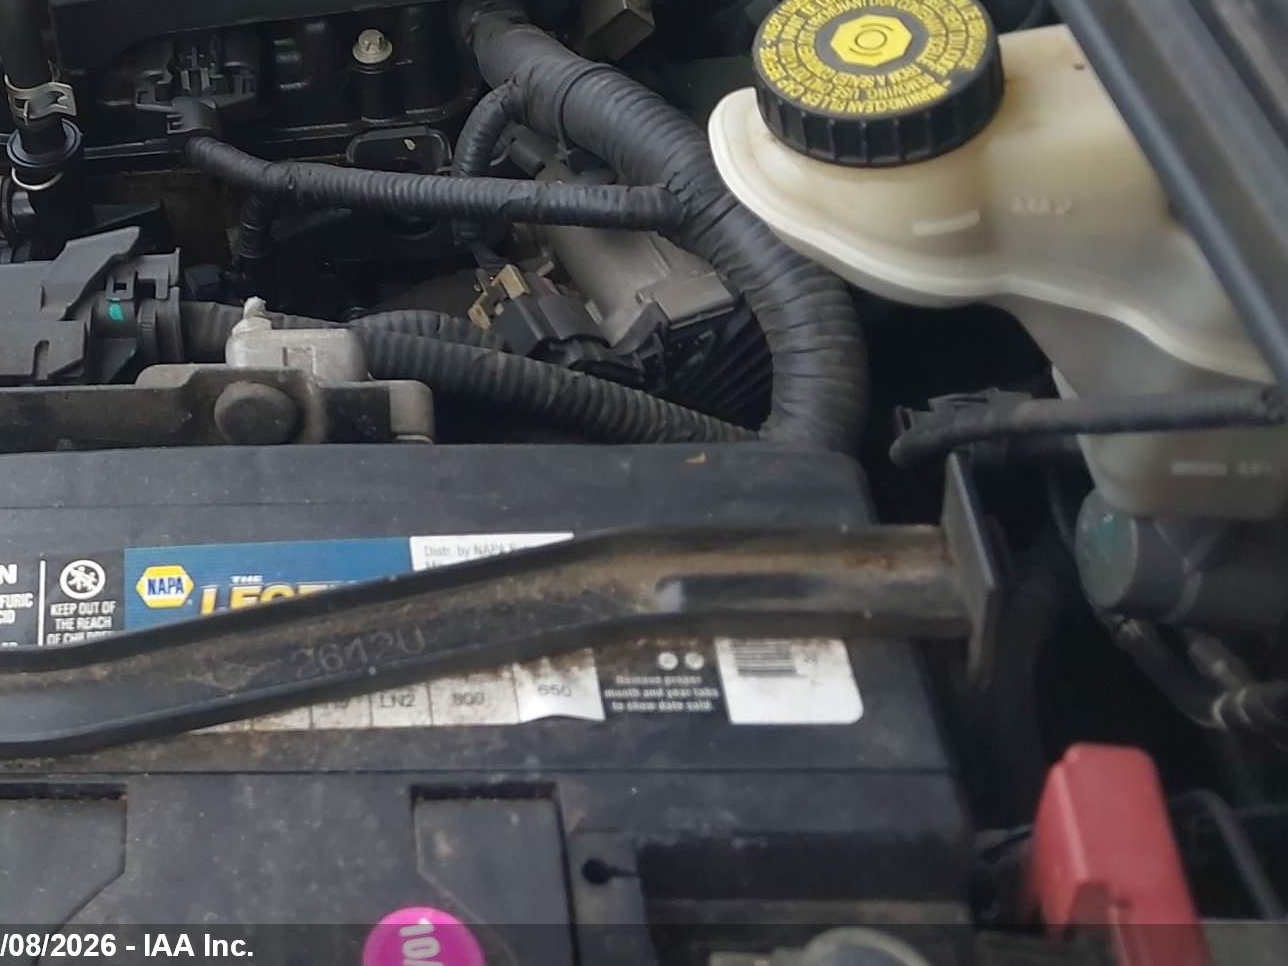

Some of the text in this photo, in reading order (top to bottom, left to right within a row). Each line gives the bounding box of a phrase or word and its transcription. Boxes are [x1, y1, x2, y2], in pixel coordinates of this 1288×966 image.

[456, 545, 470, 557] by
[230, 575, 264, 584] THE
[145, 576, 186, 597] NAPA
[49, 600, 117, 617] KEEP OUT OF
[55, 615, 112, 630] THE REACH
[47, 632, 62, 644] OF
[642, 687, 664, 698] and
